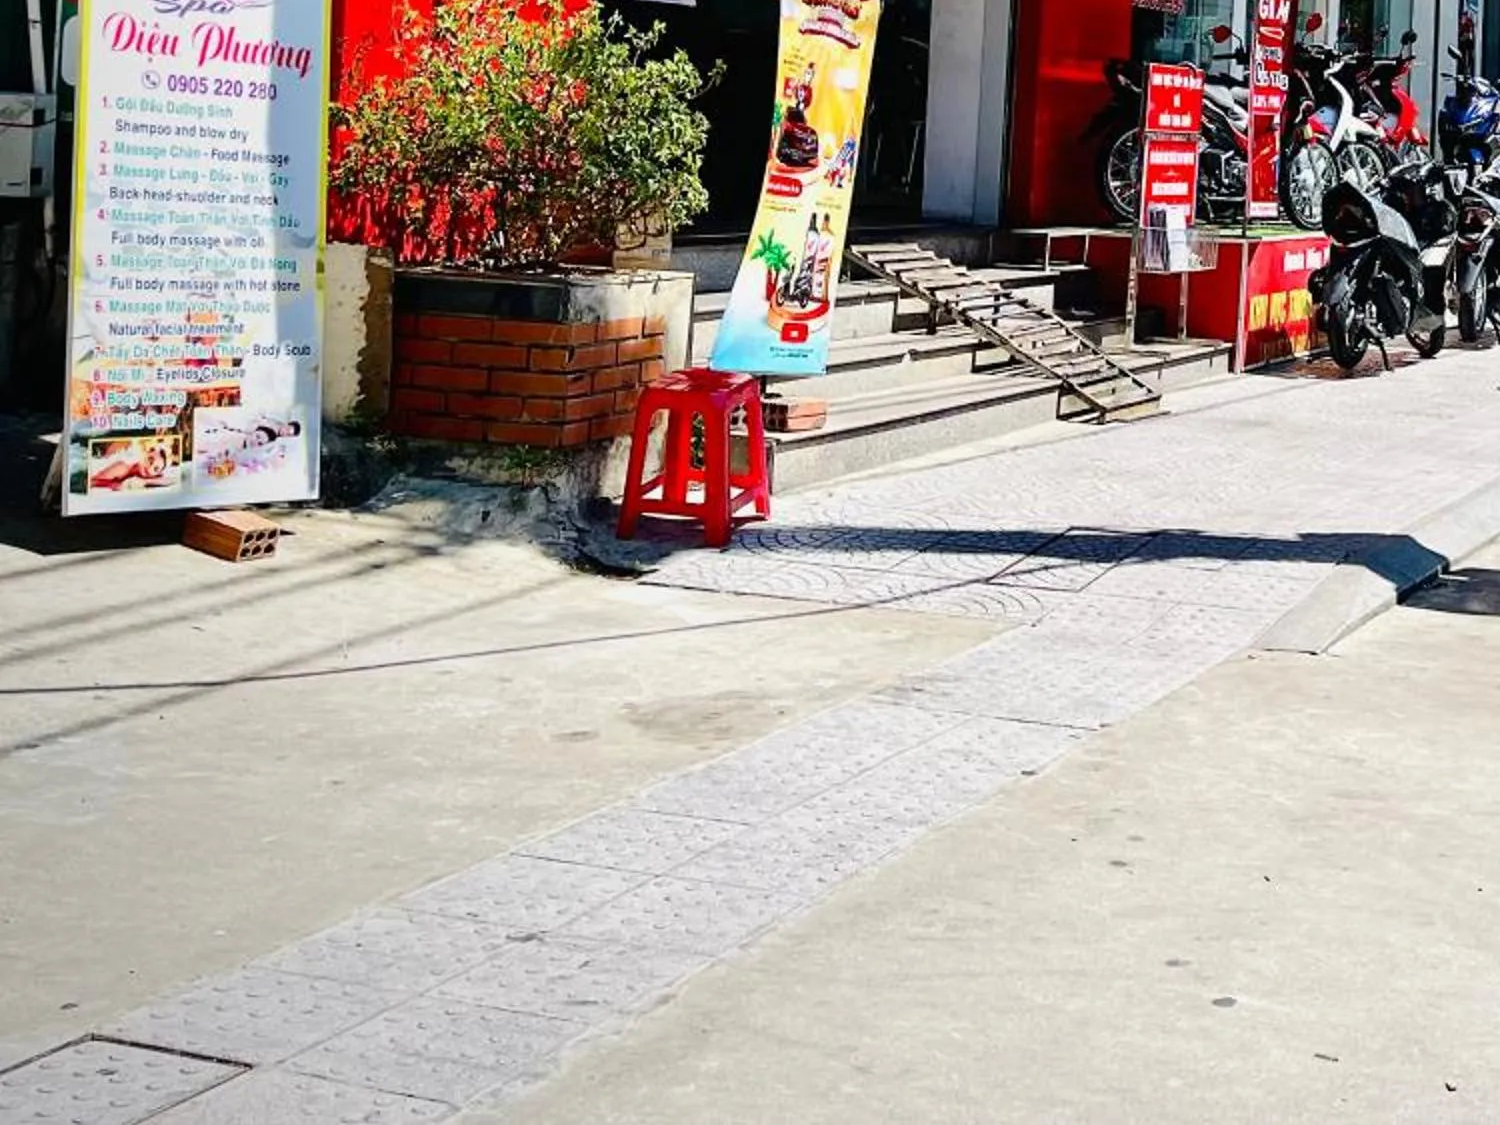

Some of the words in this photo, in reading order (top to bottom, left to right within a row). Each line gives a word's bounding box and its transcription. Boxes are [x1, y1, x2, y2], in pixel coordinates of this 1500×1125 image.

[167, 73, 208, 95] 0905
[213, 78, 243, 98] 220
[249, 82, 277, 101] 280
[115, 118, 173, 138] Shampoo
[175, 124, 197, 138] and
[199, 125, 226, 140] blow
[228, 128, 249, 144] dry
[113, 141, 167, 161] Massage
[211, 148, 238, 163] Food
[241, 150, 291, 168] Massage
[113, 164, 166, 183] Massage
[229, 192, 250, 205] and
[111, 208, 165, 225] Massage
[111, 230, 134, 245] Full
[137, 231, 165, 248] body
[169, 234, 221, 250] massage
[224, 234, 248, 247] with
[111, 254, 163, 272] Massage
[109, 276, 133, 291] Full
[135, 276, 165, 293] body
[167, 278, 219, 294] massage
[223, 278, 247, 291] with
[249, 278, 268, 292] hot
[271, 279, 301, 293] stone
[109, 300, 162, 318] Massage
[109, 322, 154, 336] Natural
[252, 344, 281, 359] Body
[108, 391, 138, 406] Body
